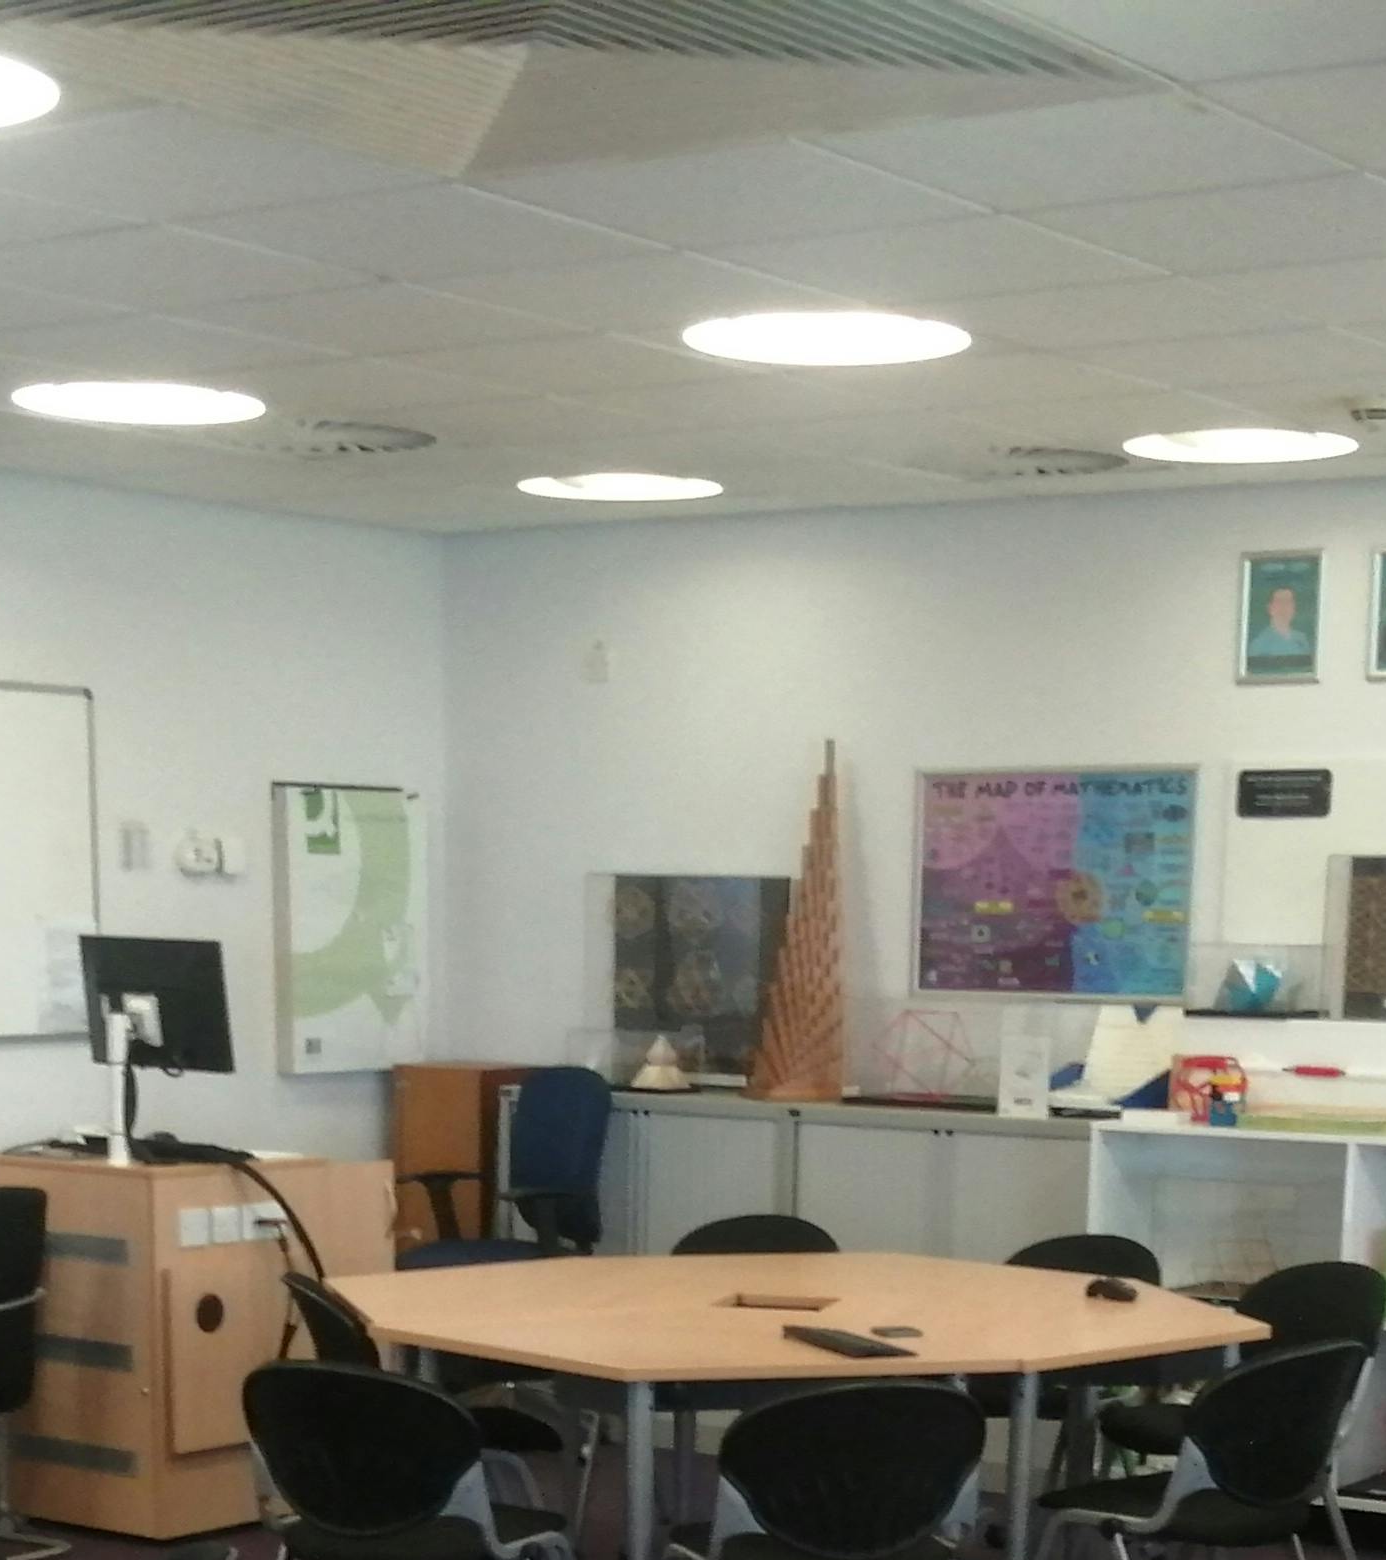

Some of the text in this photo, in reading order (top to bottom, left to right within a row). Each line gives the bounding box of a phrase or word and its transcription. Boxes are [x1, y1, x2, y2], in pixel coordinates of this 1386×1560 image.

[933, 776, 1188, 798] THE MAP OF MATHEMATICS
